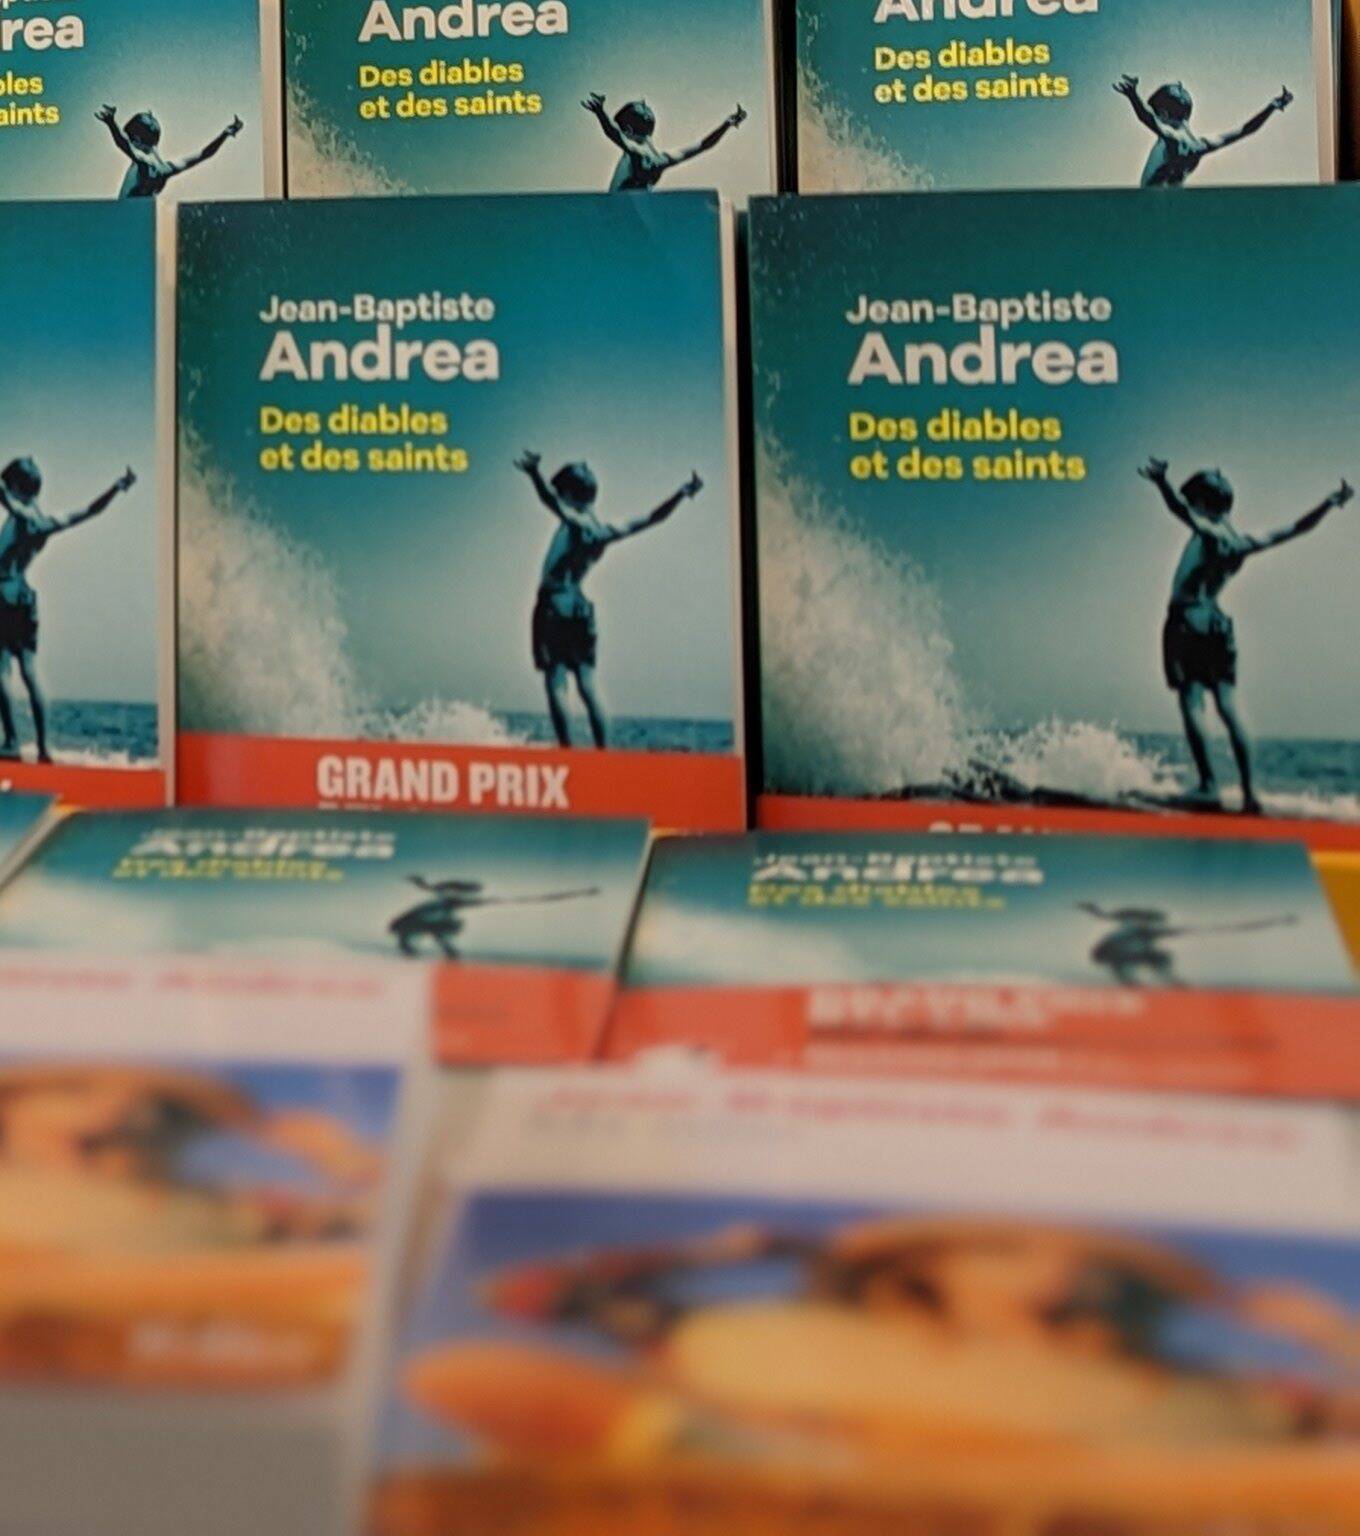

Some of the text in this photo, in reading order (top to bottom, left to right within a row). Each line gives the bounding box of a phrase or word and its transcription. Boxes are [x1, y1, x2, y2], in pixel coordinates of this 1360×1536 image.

[875, 38, 1051, 71] Des diables
[358, 57, 524, 89] Des diables
[875, 70, 1070, 104] et des saints
[358, 88, 542, 120] et des saints
[259, 291, 496, 328] Jean-Baptiste
[845, 290, 1113, 330] Jean-Baptiste
[259, 323, 500, 382] Andrea
[847, 324, 1119, 385] Andrea
[260, 402, 449, 436] Des diables
[849, 408, 1063, 442] Des diables
[260, 440, 470, 474] et des saints
[849, 447, 1087, 481] et des saints
[316, 755, 570, 809] GRAND PRIX
